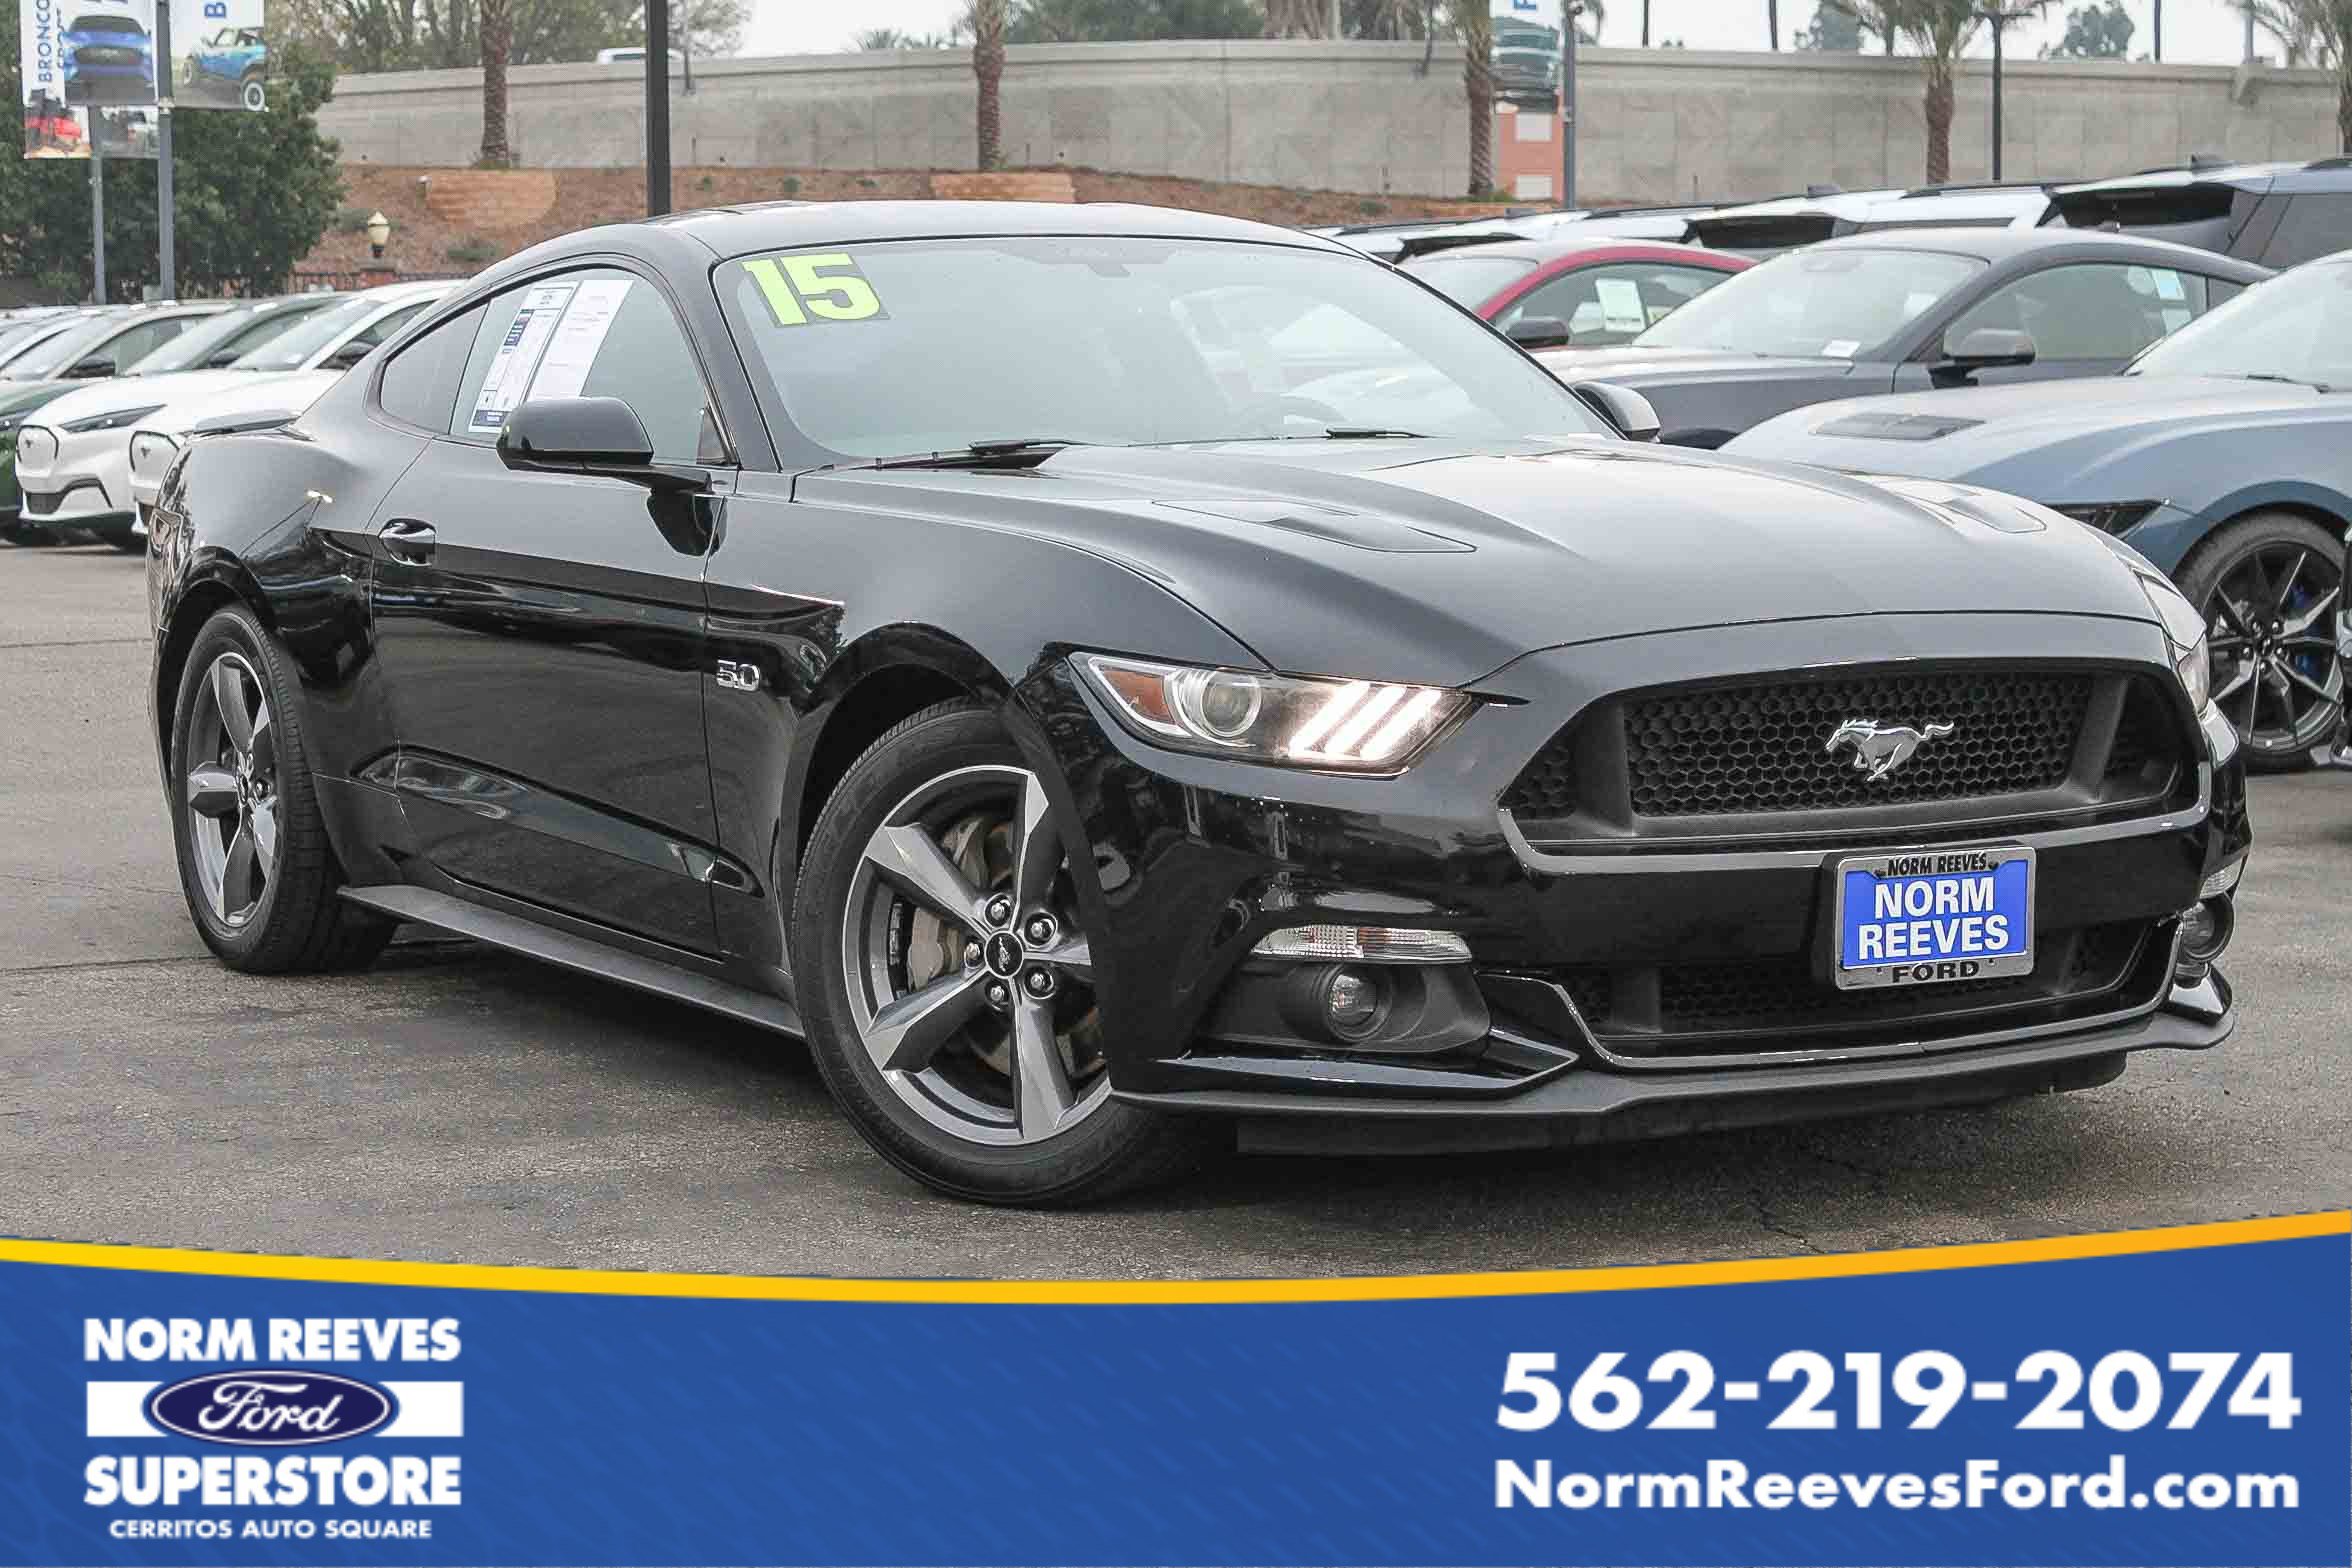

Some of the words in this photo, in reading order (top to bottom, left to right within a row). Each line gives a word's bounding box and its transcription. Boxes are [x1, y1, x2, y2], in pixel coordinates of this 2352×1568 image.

[36, 0, 53, 82] BRONCO
[741, 252, 881, 326] 15
[1887, 856, 1932, 876] NORM
[1936, 852, 1987, 872] REEVES
[1874, 876, 1994, 920] NORM
[1858, 914, 2009, 960] REEVES
[1892, 960, 1980, 983] FORD
